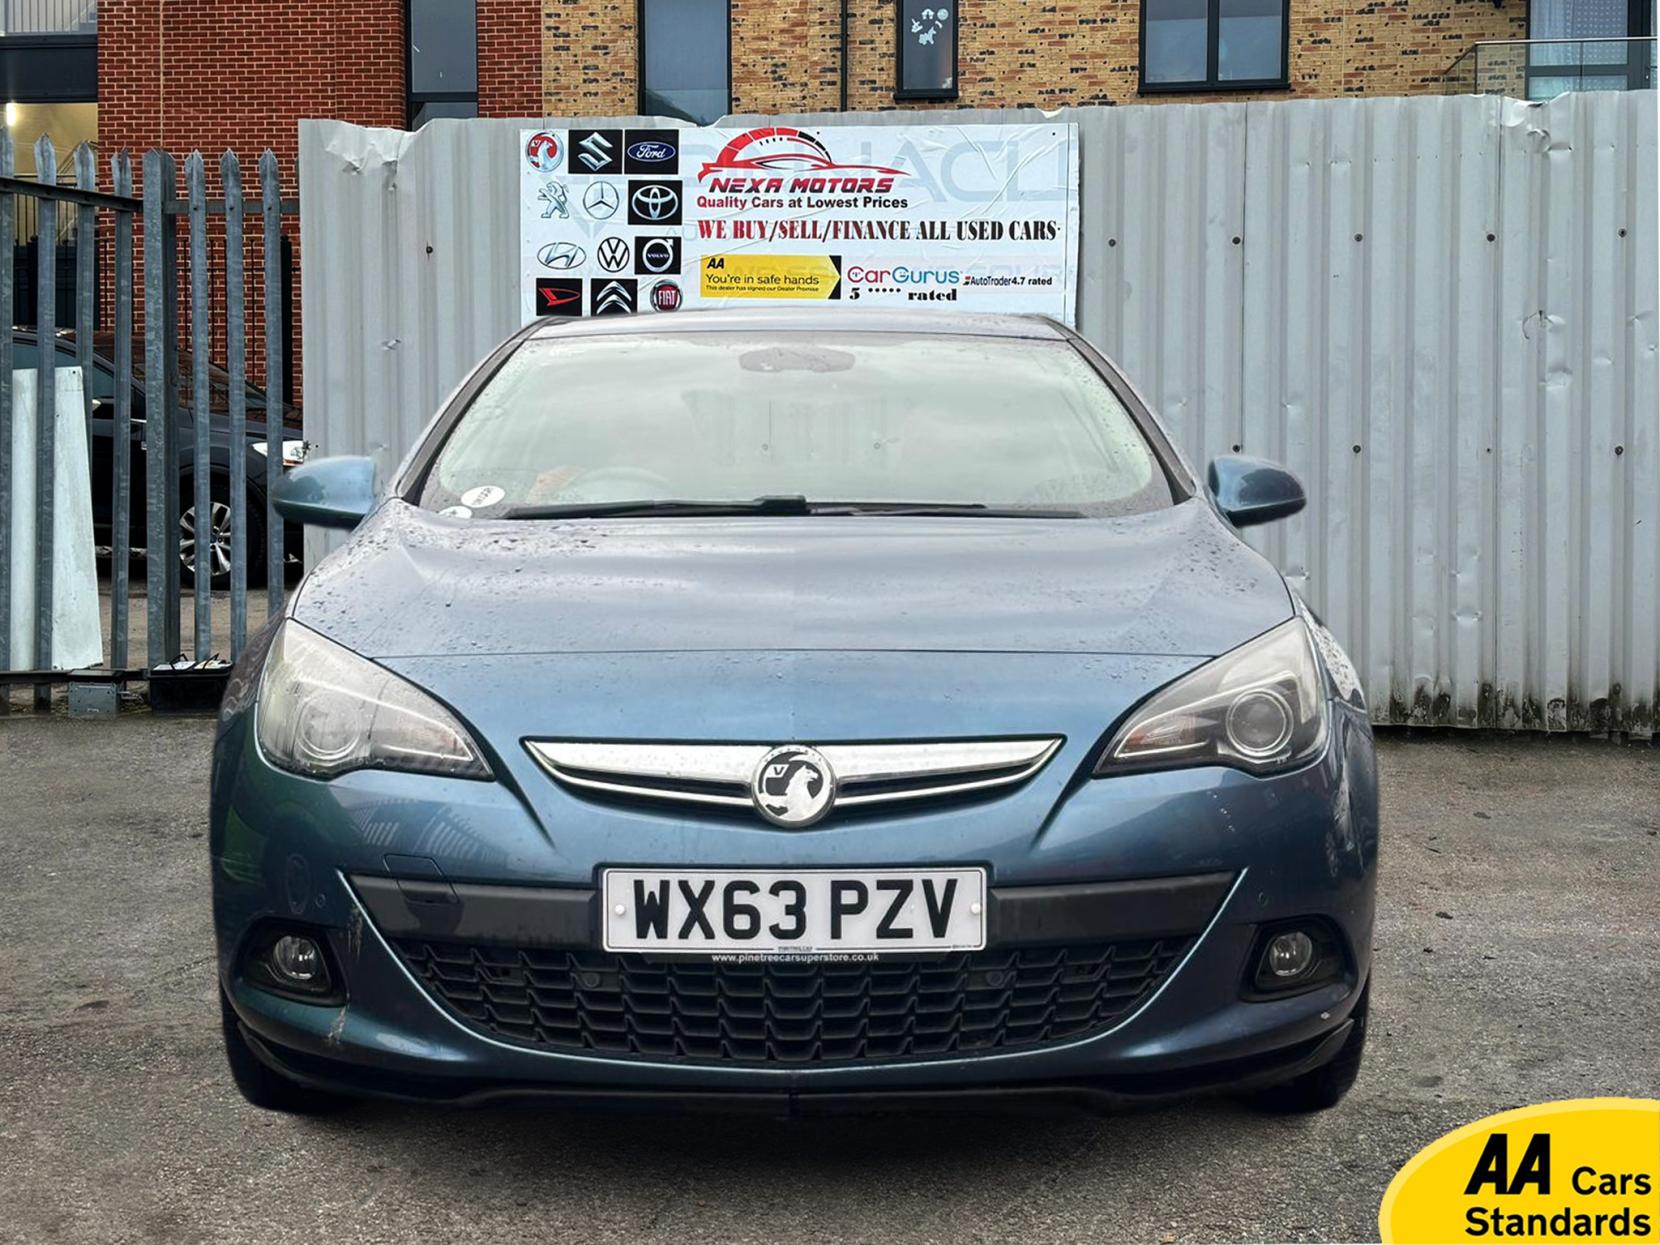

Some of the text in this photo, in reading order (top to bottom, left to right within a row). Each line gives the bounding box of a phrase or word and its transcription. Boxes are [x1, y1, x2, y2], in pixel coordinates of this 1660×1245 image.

[636, 144, 666, 159] Ford
[709, 178, 895, 193] NEXA MOTORS
[697, 196, 908, 211] Quality Cars at Lowest Prices
[697, 220, 727, 240] WE
[916, 220, 951, 240] ALL
[956, 220, 1004, 240] USED
[1008, 220, 1057, 241] CARS
[706, 257, 725, 269] AA
[705, 274, 819, 285] You're in safe hands
[847, 266, 960, 284] CarGurus
[1027, 276, 1053, 286] rated
[658, 290, 677, 305] FIAT
[849, 287, 957, 301] 5 rated
[633, 878, 959, 940] WX63 PZV
[711, 953, 880, 964] www.pinetreecarsuperstore.co.uk
